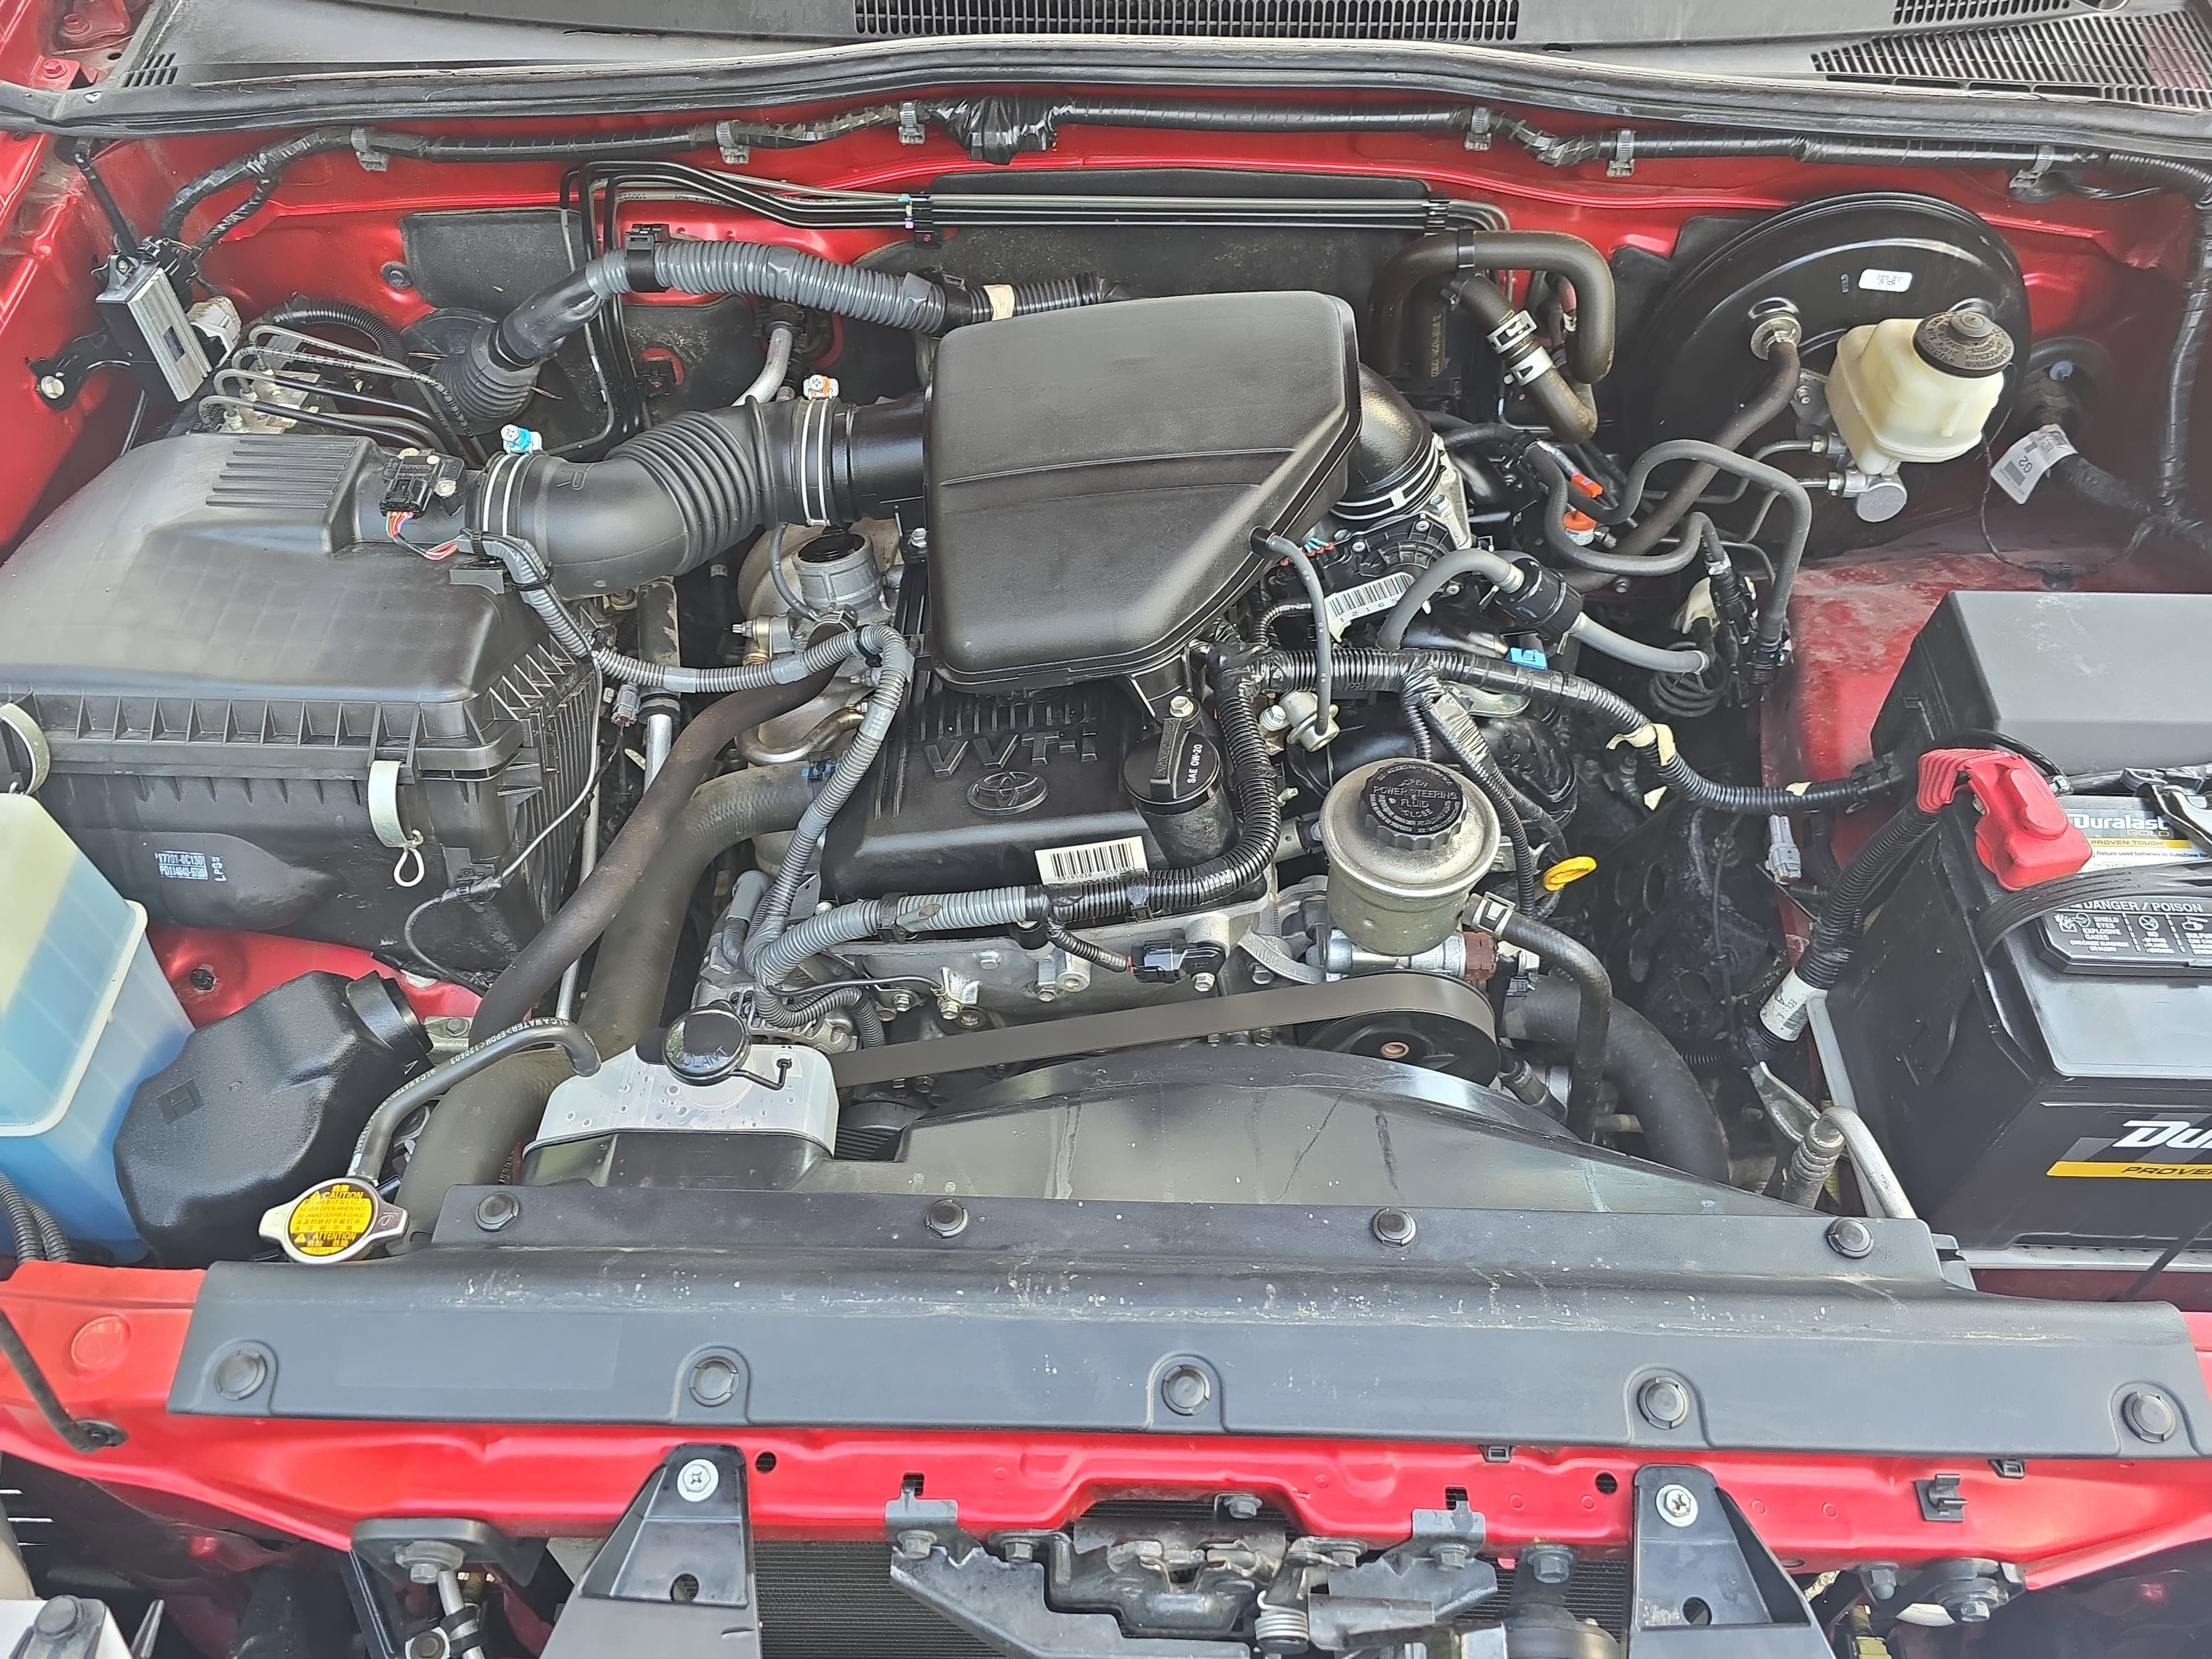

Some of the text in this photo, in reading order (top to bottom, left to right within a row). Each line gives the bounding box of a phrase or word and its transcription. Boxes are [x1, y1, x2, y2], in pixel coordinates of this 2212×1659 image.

[2018, 455, 2033, 473] G2
[1187, 744, 1203, 784] SAE 0W-20
[1400, 799, 1430, 808] FLUID
[2066, 813, 2168, 830] Duralast
[2083, 901, 2141, 911] DANGER
[2150, 902, 2203, 913] POISON
[312, 1232, 357, 1241] ATTENTION
